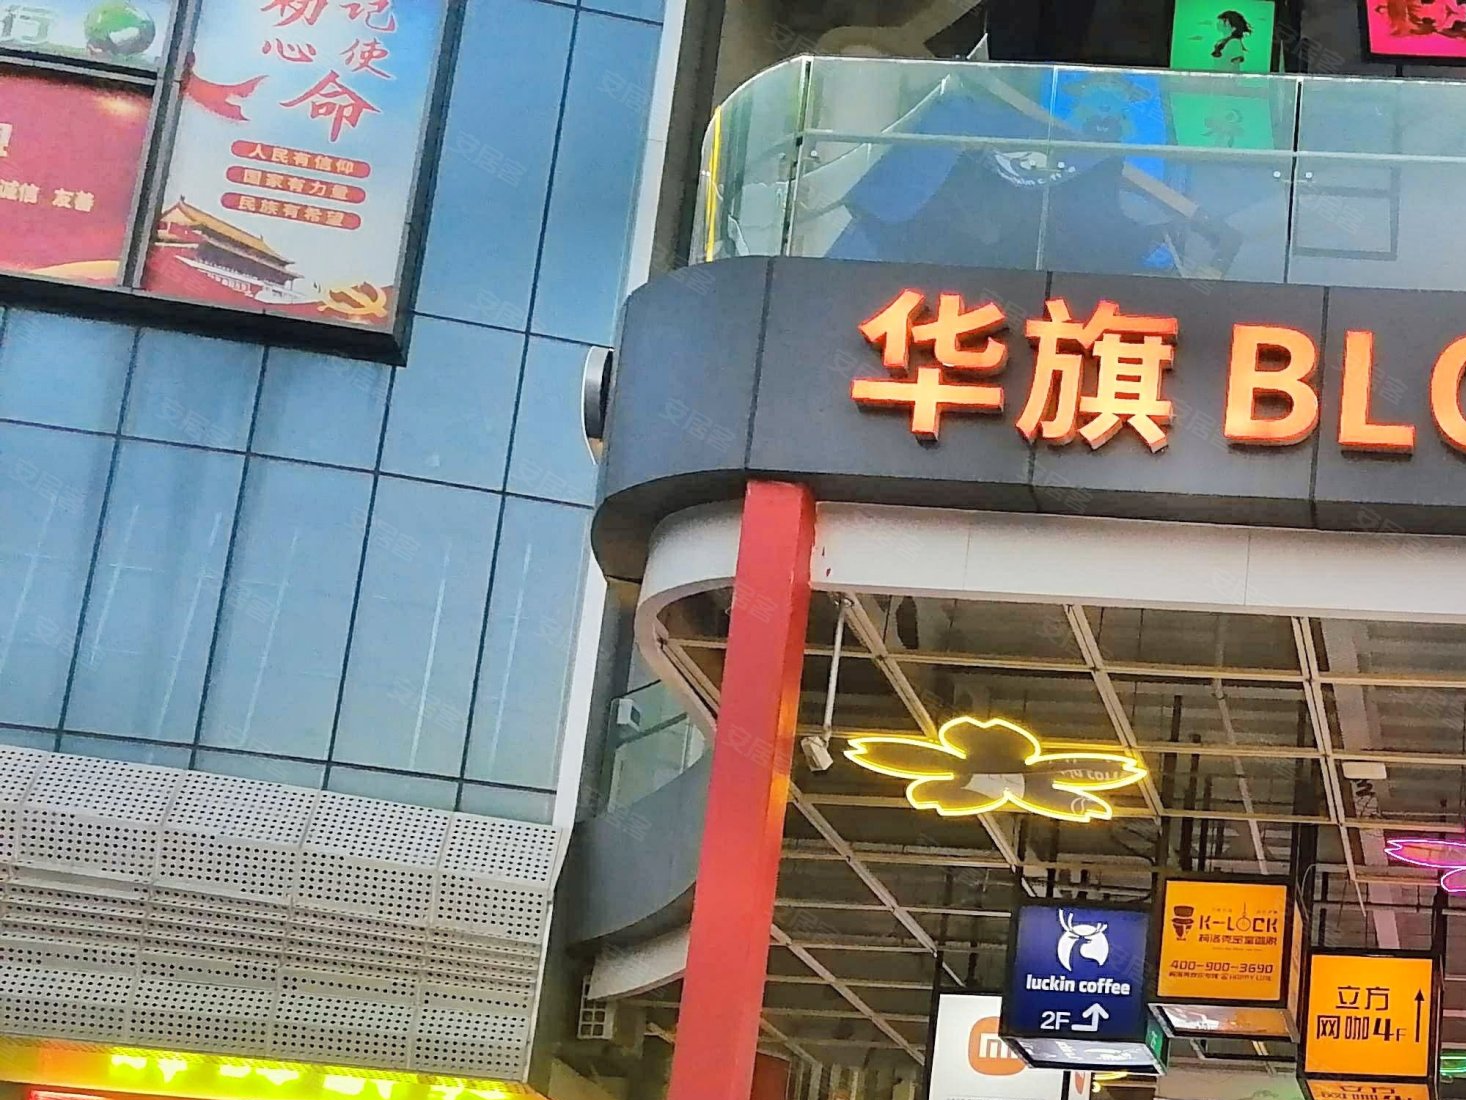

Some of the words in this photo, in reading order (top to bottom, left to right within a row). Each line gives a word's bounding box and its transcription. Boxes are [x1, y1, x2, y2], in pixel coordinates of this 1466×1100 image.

[247, 142, 355, 177] 人民有信仰
[242, 168, 351, 202] 国家有力量
[51, 187, 96, 214] 友善
[237, 195, 347, 229] 民族有希望
[850, 287, 1180, 455] 华旗
[1170, 959, 1274, 975] 400-900-3690
[1025, 973, 1076, 994] luckin
[1078, 976, 1131, 996] coffee
[1335, 984, 1391, 1011] 立方
[1039, 1010, 1072, 1031] 2F
[1315, 1013, 1407, 1042] 网咖4F
